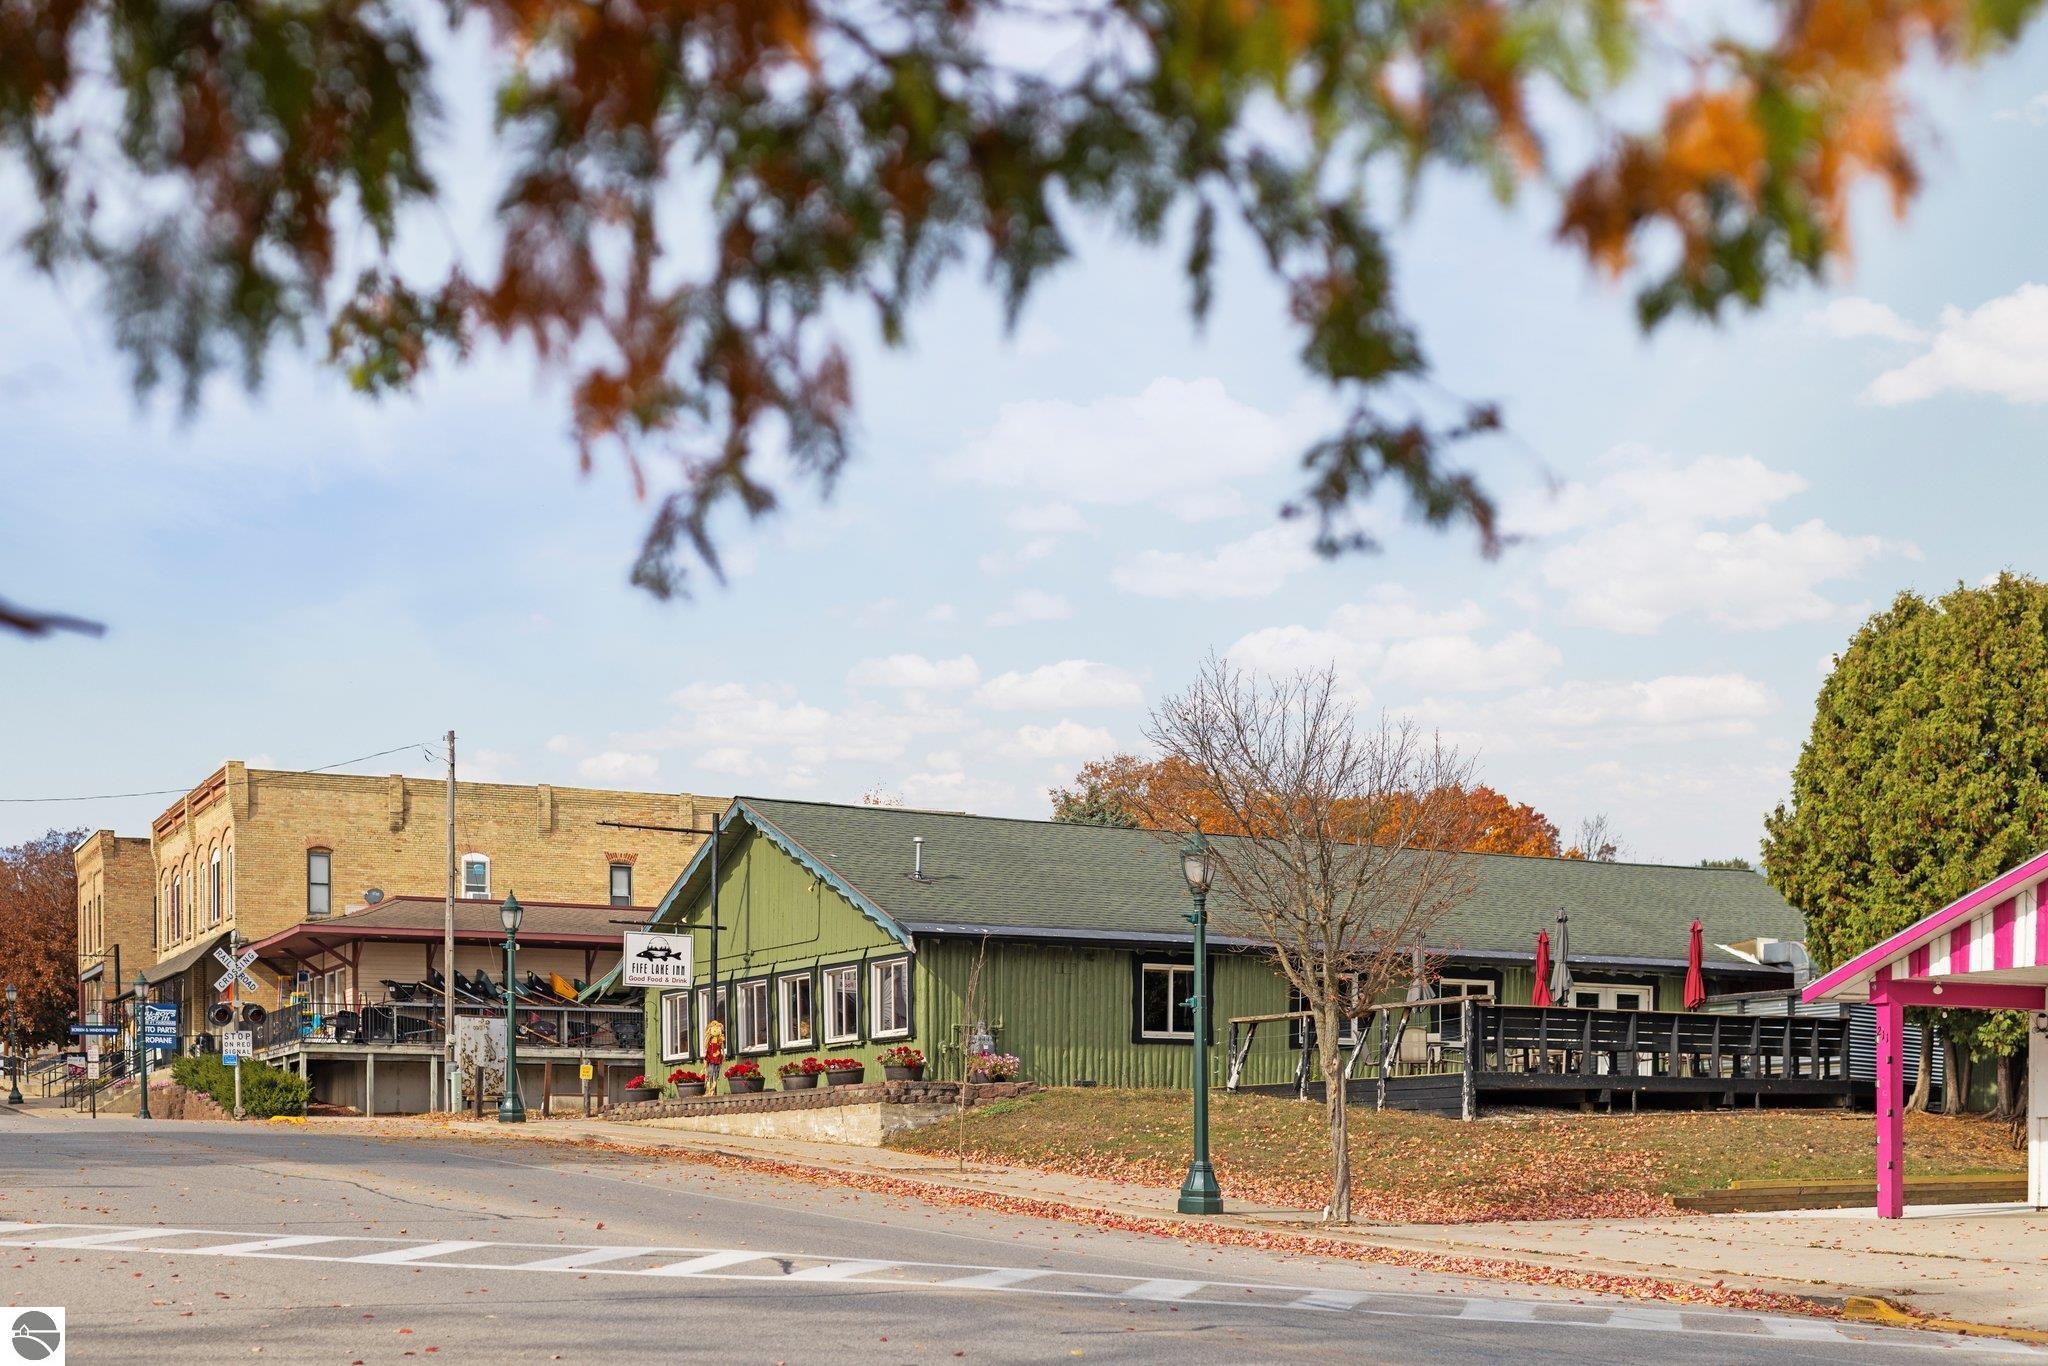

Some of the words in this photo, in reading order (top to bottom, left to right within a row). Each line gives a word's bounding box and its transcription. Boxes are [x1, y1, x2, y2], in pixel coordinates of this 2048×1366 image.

[216, 951, 232, 967] RAIL
[239, 972, 256, 991] ROAD
[218, 952, 255, 988] CROSSING
[632, 962, 647, 974] FIFE
[652, 964, 669, 975] LAKE
[673, 965, 685, 975] INN
[224, 1032, 251, 1040] STOP
